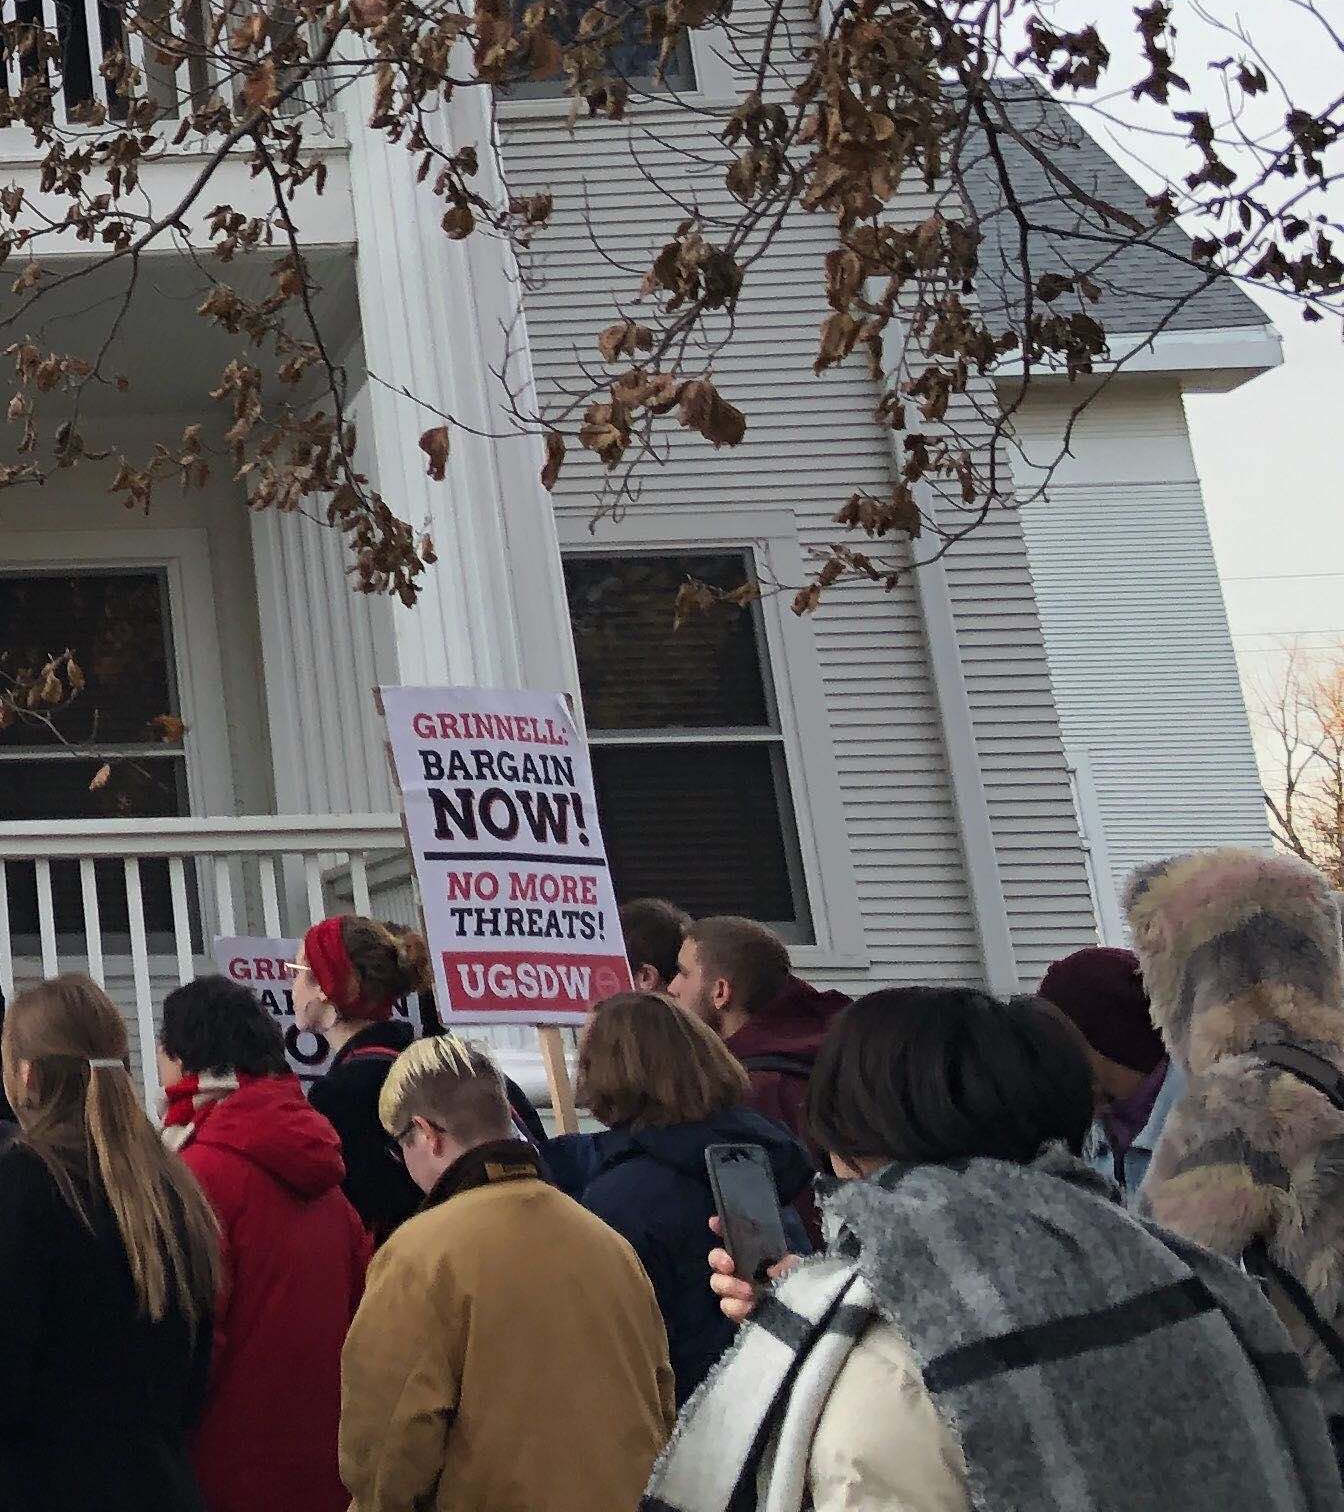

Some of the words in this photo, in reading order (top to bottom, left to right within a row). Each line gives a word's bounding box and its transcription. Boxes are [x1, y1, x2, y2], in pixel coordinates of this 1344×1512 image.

[412, 713, 569, 746] GRINNELL:
[418, 749, 576, 787] BARGAIN
[427, 787, 590, 847] NOW!
[446, 872, 500, 901] NO
[508, 872, 598, 905] MORE
[450, 907, 606, 941] THREATS!
[457, 963, 592, 1000] UGSDW
